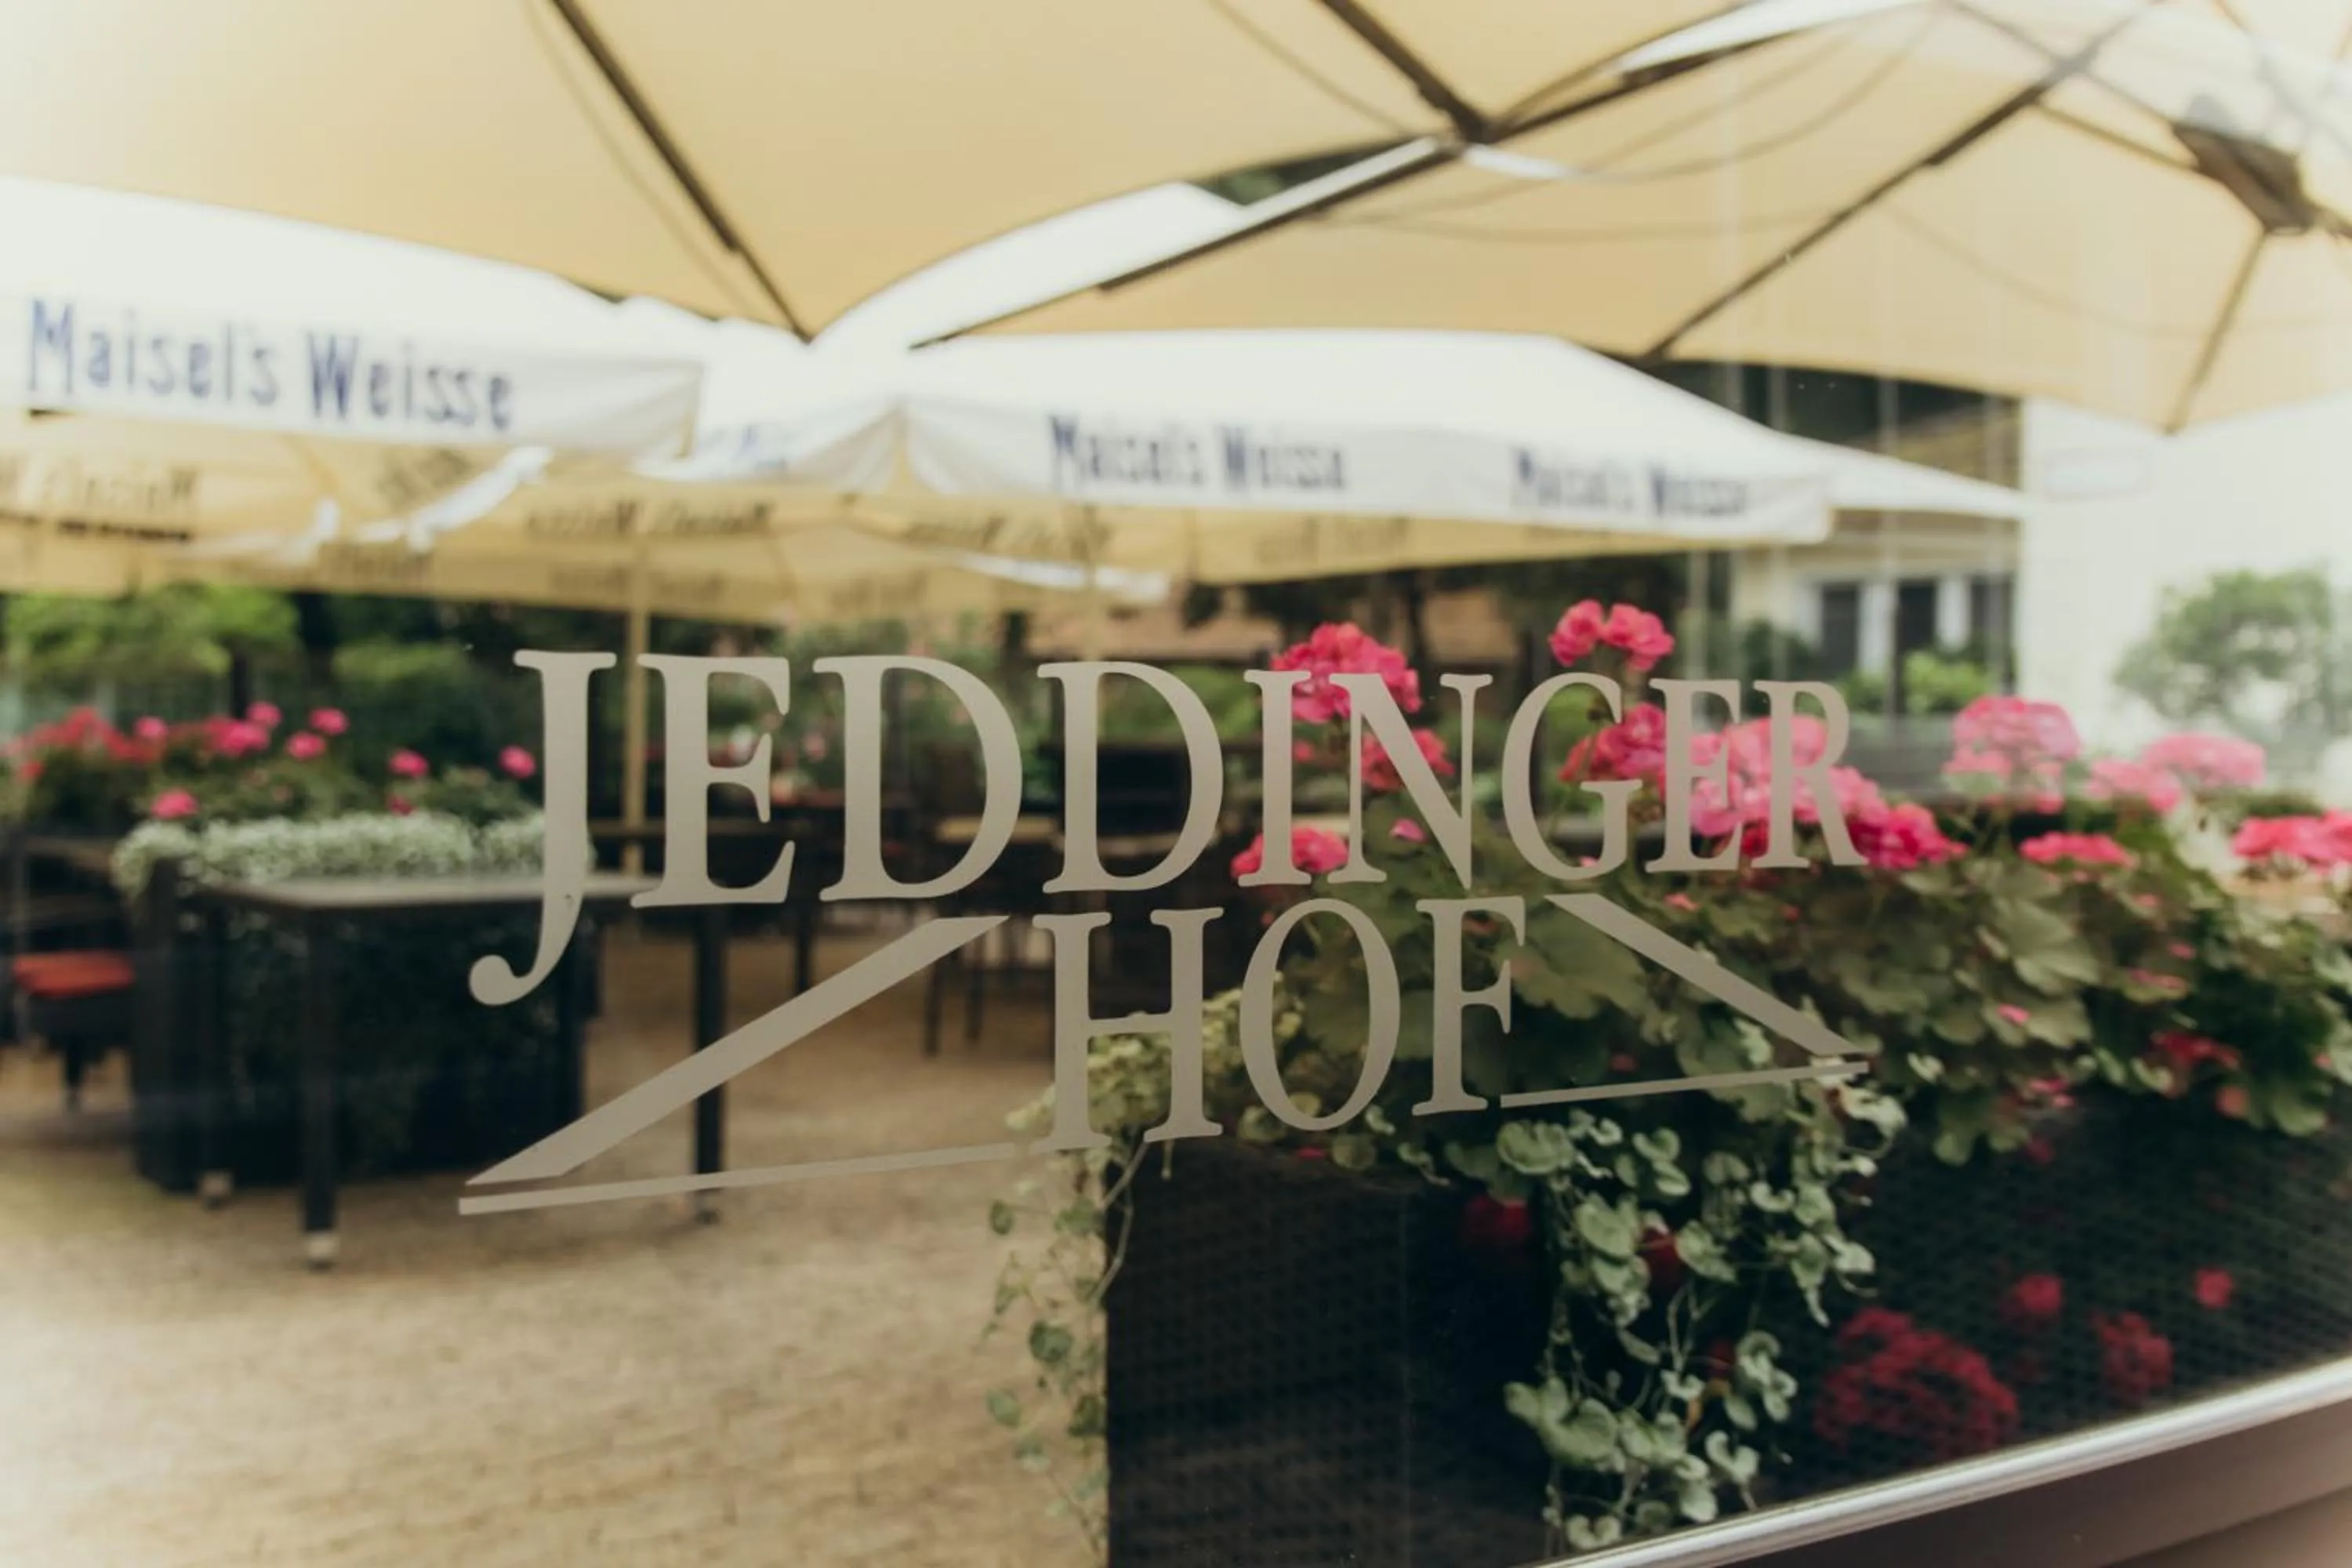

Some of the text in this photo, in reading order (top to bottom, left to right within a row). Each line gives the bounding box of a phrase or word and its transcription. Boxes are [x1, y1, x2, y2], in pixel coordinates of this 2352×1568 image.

[27, 297, 514, 431] Maisel's Weisse
[468, 648, 1869, 1006] JEDDINGER
[1031, 895, 1526, 1153] HOF
